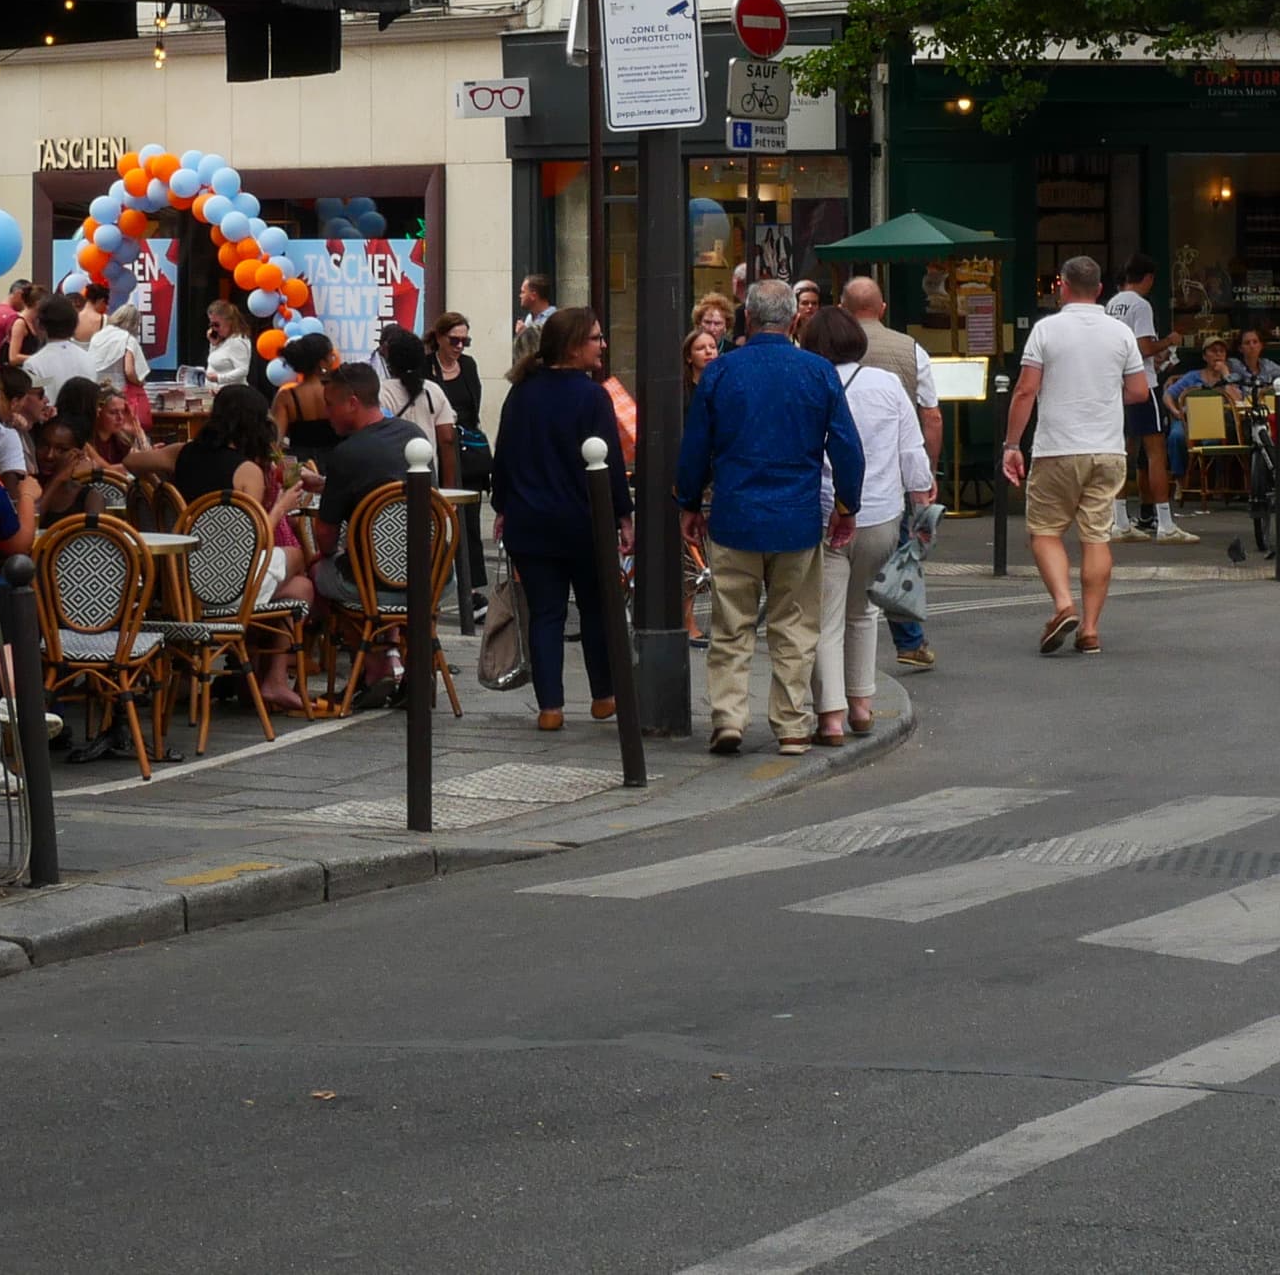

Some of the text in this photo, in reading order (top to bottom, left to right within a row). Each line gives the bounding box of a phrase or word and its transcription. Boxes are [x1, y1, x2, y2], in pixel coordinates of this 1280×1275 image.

[631, 24, 669, 34] ZONE DE
[609, 33, 692, 45] VIDÉOPROTECTION
[746, 64, 778, 79] SAUF
[754, 137, 786, 149] PIÉTONS
[35, 137, 128, 171] TASCHEN
[304, 253, 402, 284] TASCHEN
[312, 285, 395, 317] VENTE
